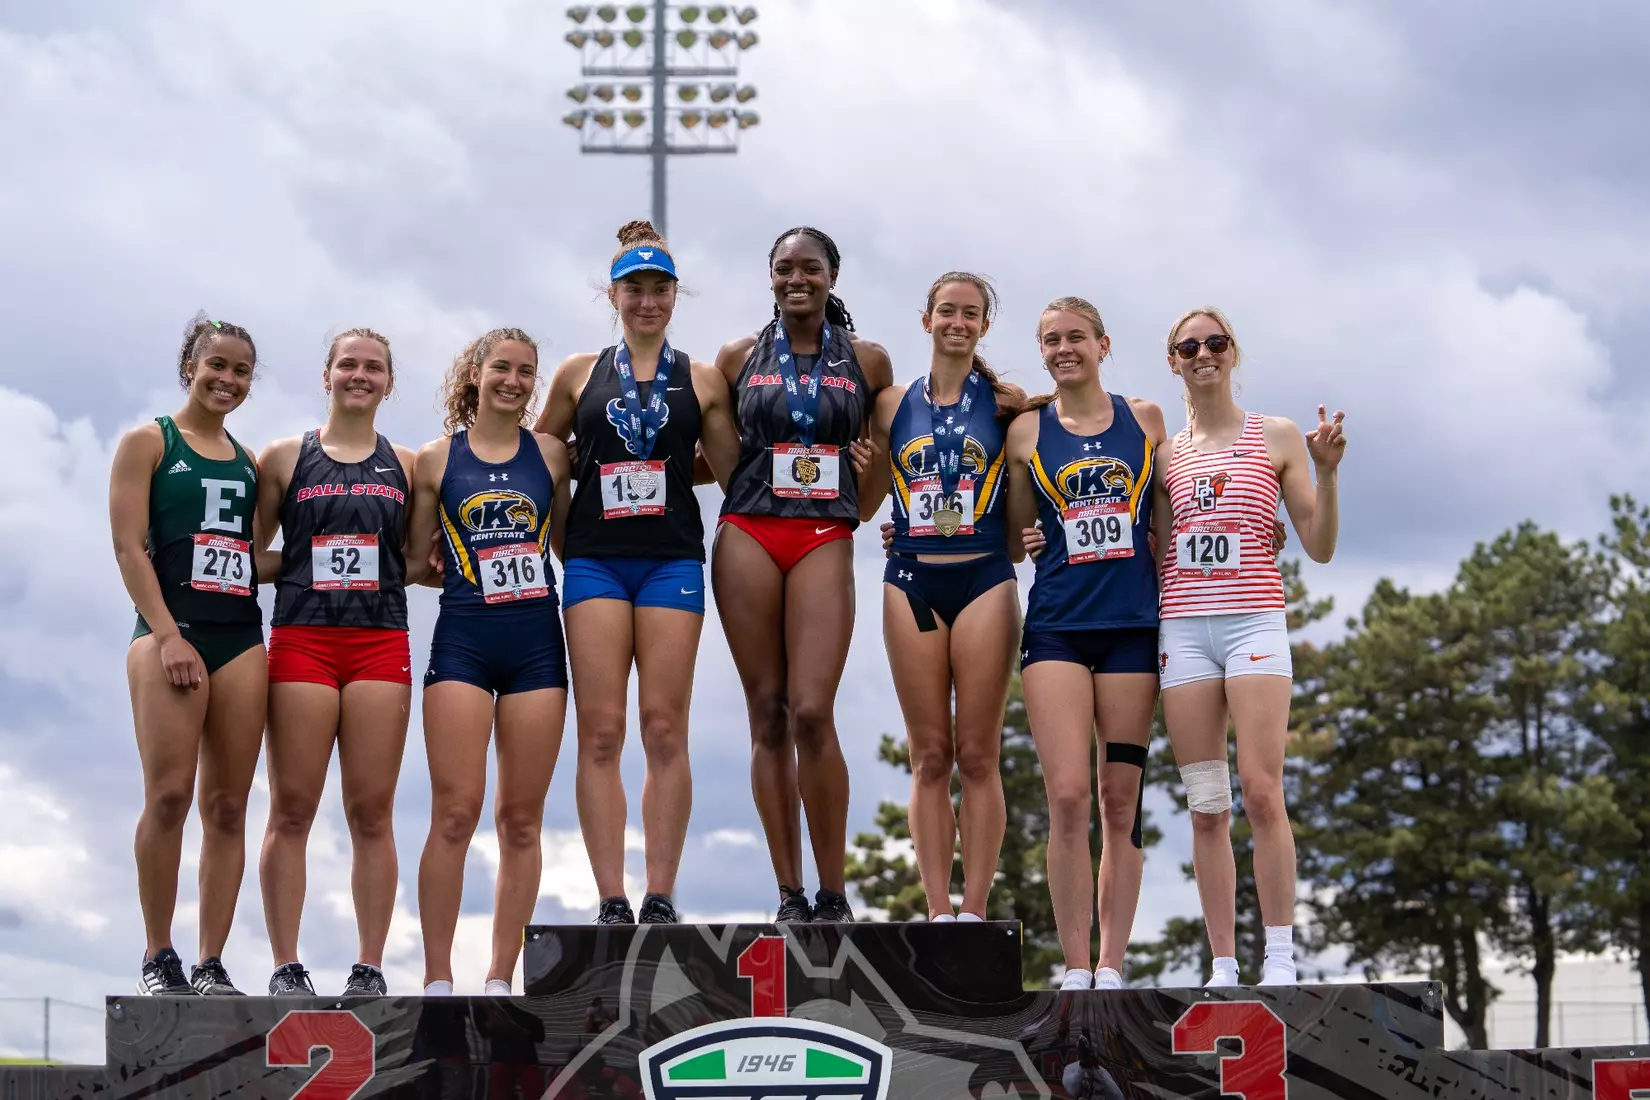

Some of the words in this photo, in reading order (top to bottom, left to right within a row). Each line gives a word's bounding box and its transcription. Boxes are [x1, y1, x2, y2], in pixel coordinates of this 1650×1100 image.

[747, 374, 783, 387] BAL
[200, 478, 246, 534] E
[297, 484, 348, 503] BALL
[351, 483, 405, 505] STATE
[1068, 501, 1092, 510] KENT
[1094, 496, 1122, 505] STATE
[471, 532, 494, 542] KENT
[498, 531, 525, 539] STATE
[1075, 516, 1121, 547] 309
[203, 548, 244, 579] 273
[331, 547, 361, 575] 52
[1186, 535, 1229, 563] 120
[491, 555, 535, 588] 316
[736, 934, 788, 1018] 1
[265, 1010, 376, 1100] 2
[737, 1054, 797, 1073] 1946
[1172, 1001, 1288, 1100] 3
